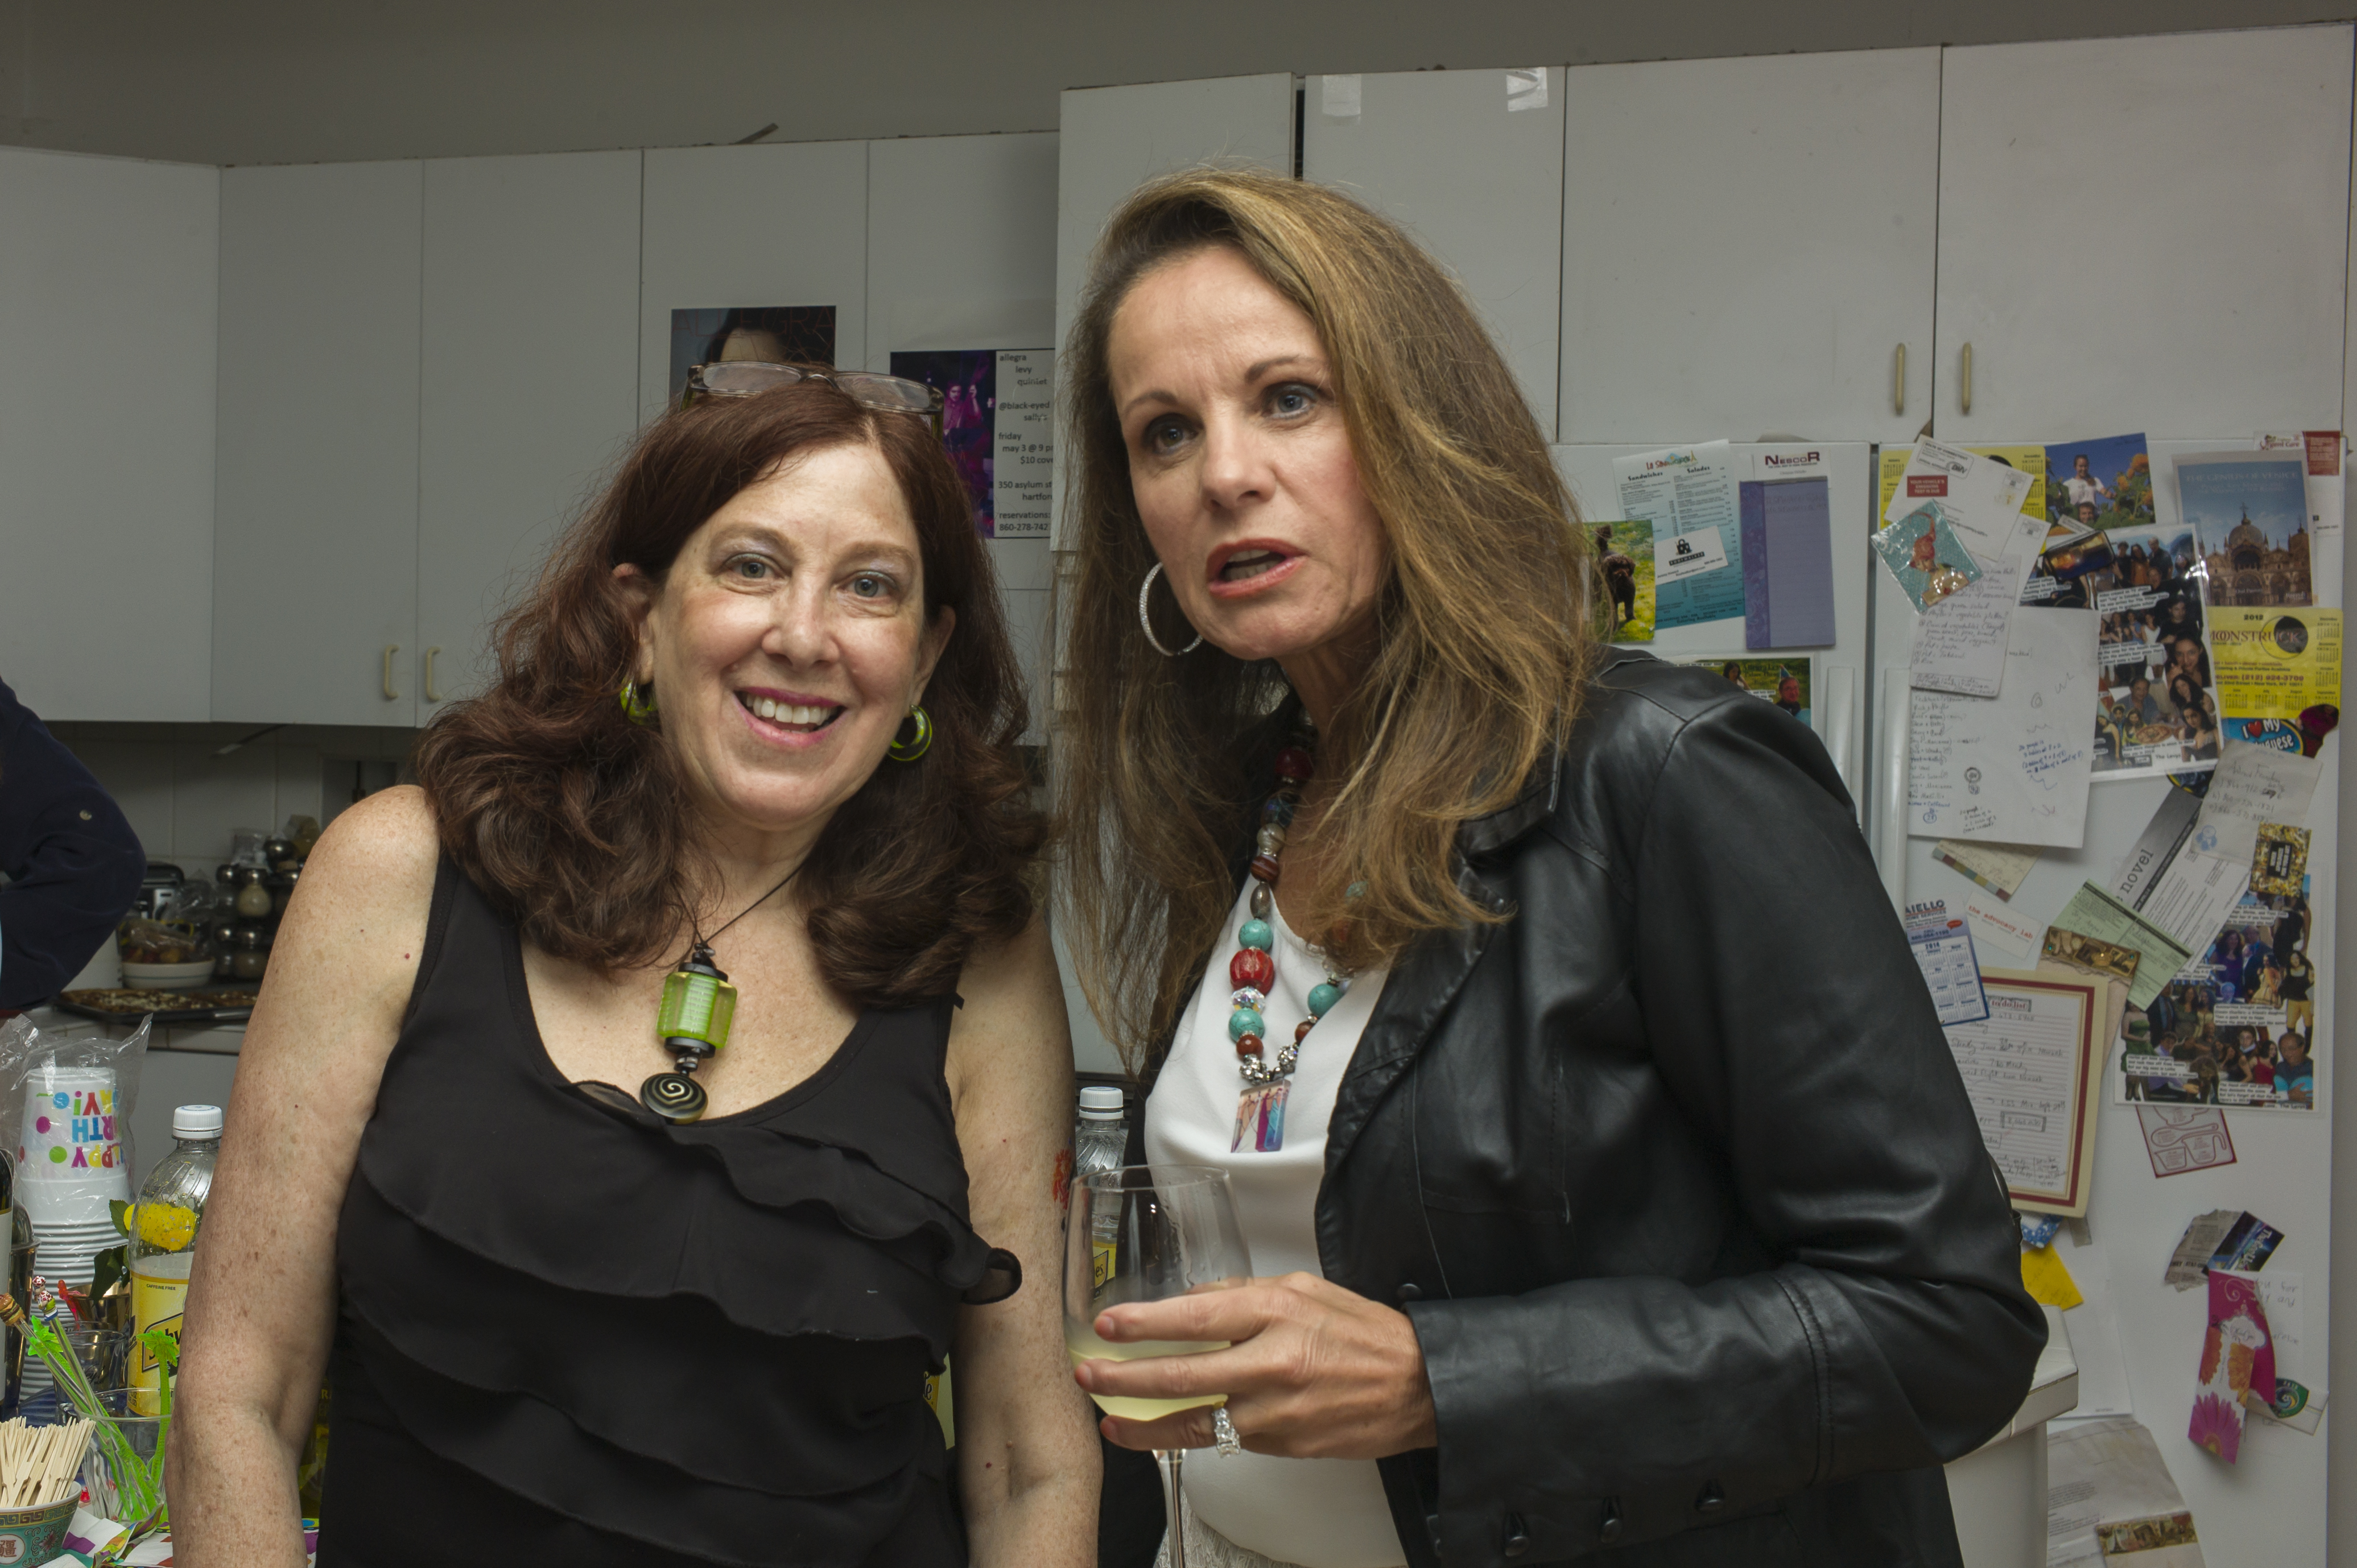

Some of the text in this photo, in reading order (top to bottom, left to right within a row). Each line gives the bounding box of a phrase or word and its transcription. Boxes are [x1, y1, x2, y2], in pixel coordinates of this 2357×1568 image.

[999, 353, 1027, 363] allegra
[1016, 366, 1033, 374] levy
[998, 401, 1050, 411] @black-eyed
[998, 432, 1022, 441] friday
[1027, 444, 1037, 453] @
[1020, 456, 1035, 465] $10
[1628, 471, 1663, 482] Sandwiches
[1014, 481, 1043, 490] asylum
[2262, 718, 2281, 733] My
[2120, 849, 2154, 895] novel
[1905, 899, 1945, 913] AIELLO
[1968, 905, 2033, 940] the advocacy lab
[2013, 1000, 2026, 1010] list
